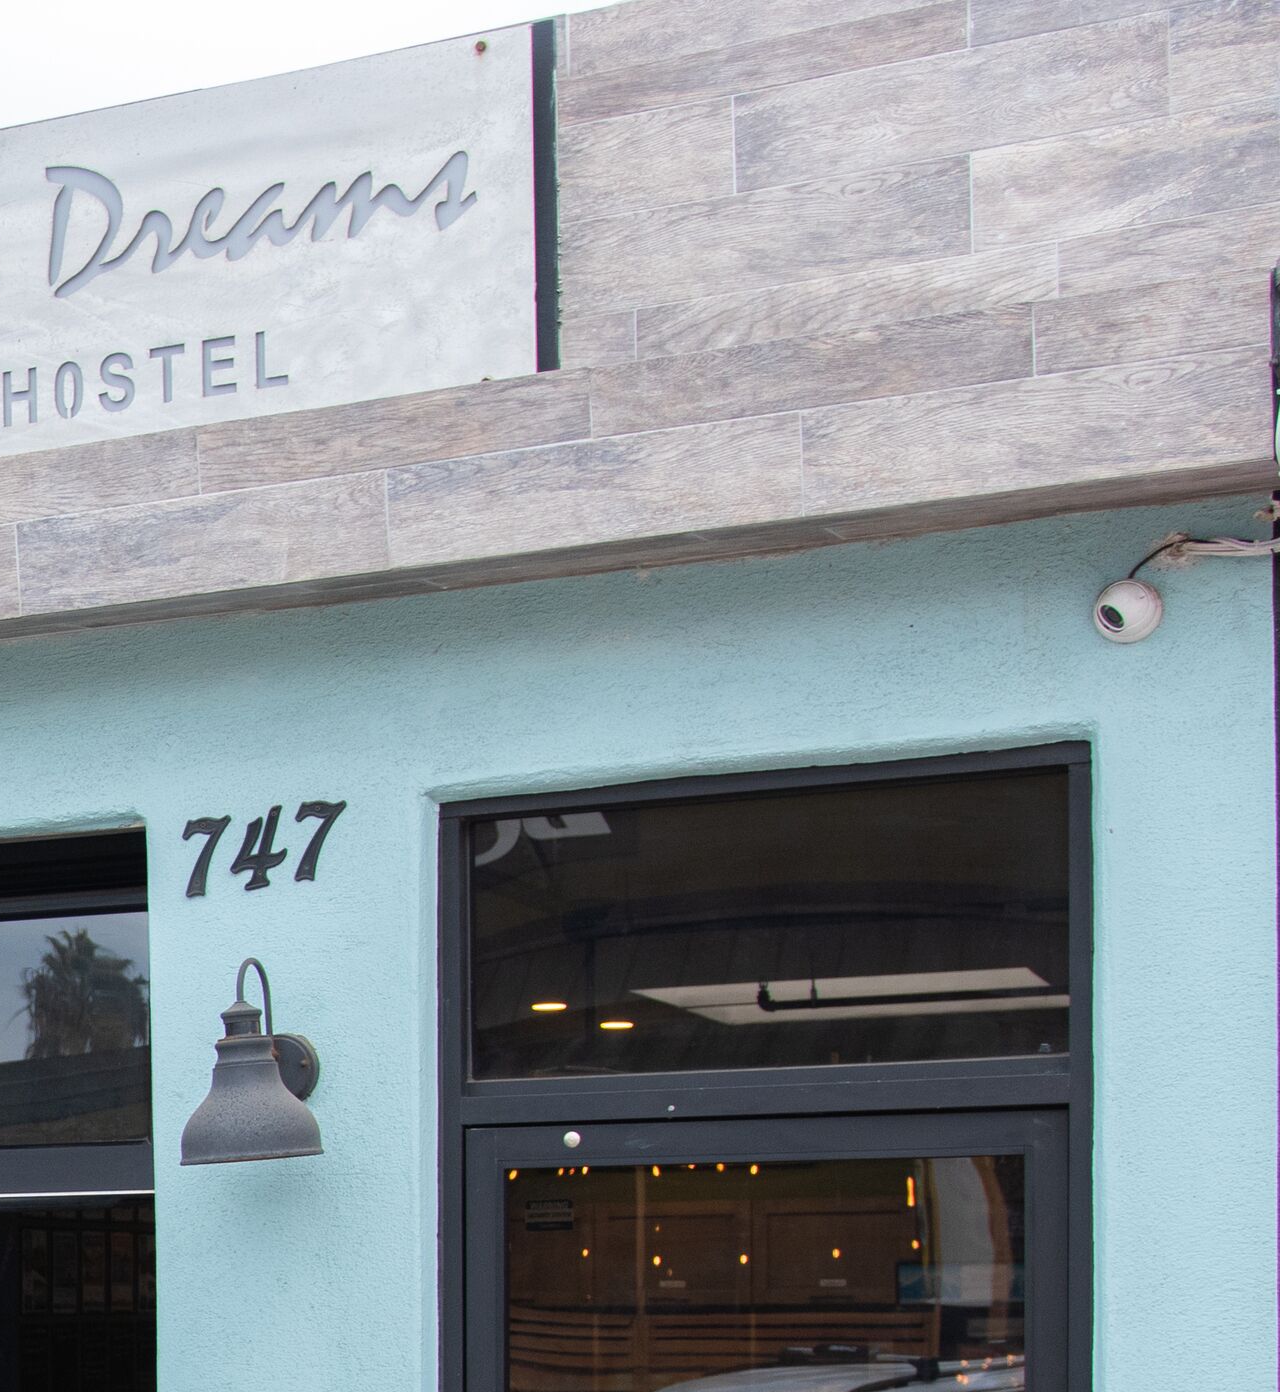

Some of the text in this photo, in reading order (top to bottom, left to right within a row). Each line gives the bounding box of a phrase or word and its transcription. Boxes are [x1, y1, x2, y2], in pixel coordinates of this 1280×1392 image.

[46, 148, 478, 298] Dreams
[2, 329, 291, 430] HOSTEL
[182, 800, 347, 898] 747
